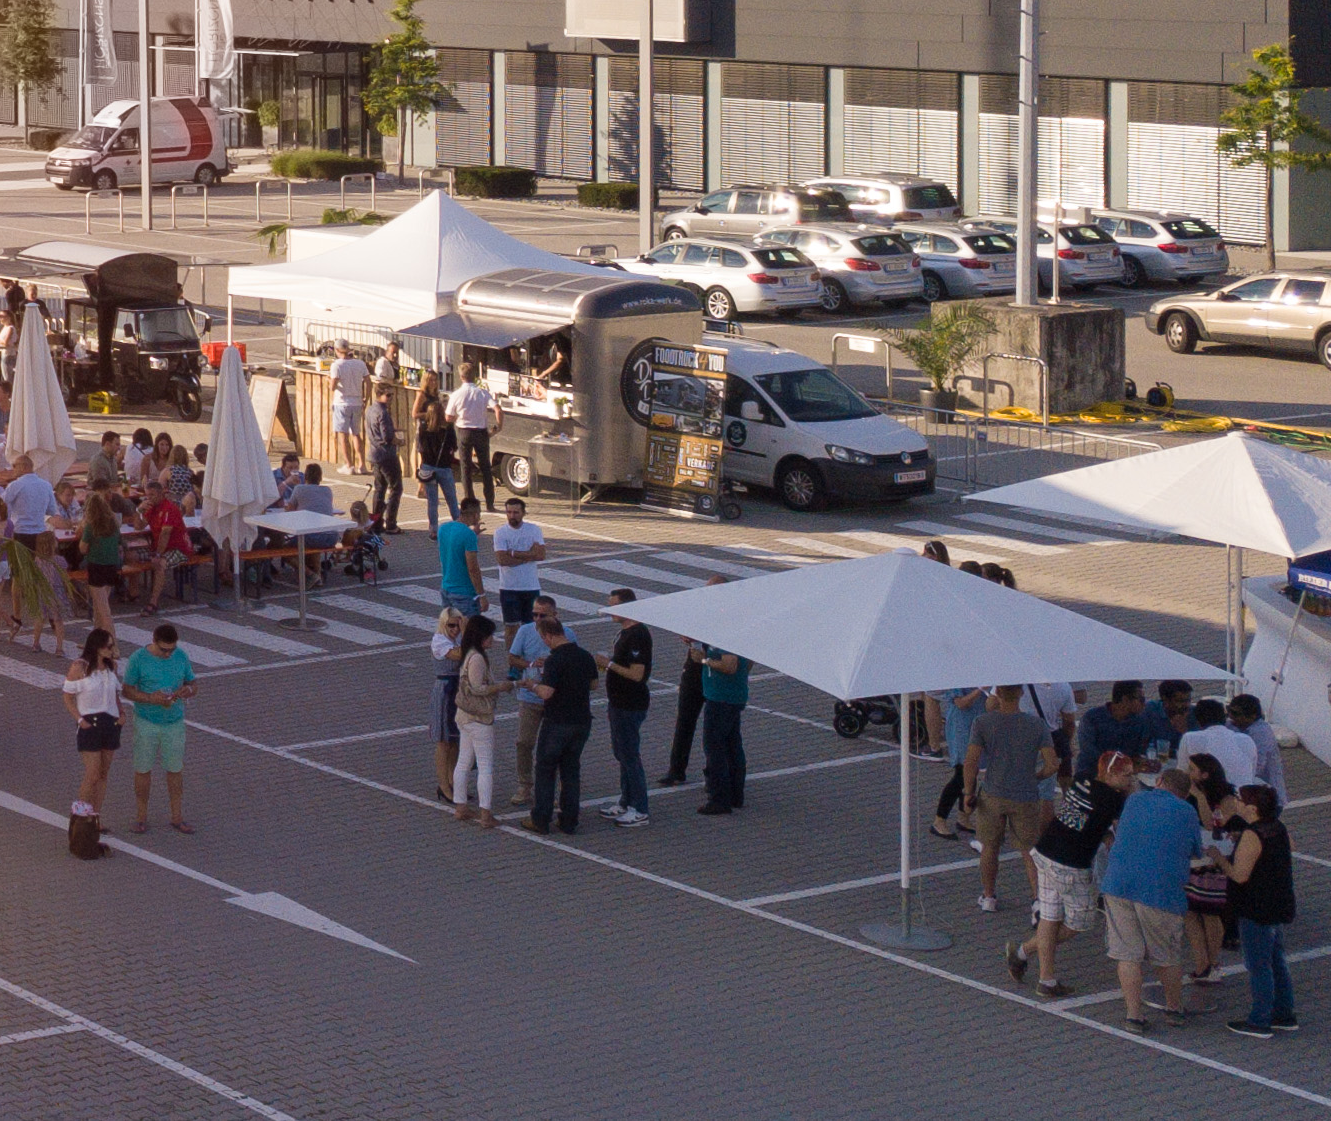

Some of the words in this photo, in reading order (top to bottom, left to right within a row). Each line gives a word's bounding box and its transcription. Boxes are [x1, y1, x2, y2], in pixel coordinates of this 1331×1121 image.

[655, 347, 699, 369] FOODTRUCK
[698, 352, 709, 371] 4
[708, 354, 725, 372] YOU
[686, 457, 716, 471] VERKAUF
